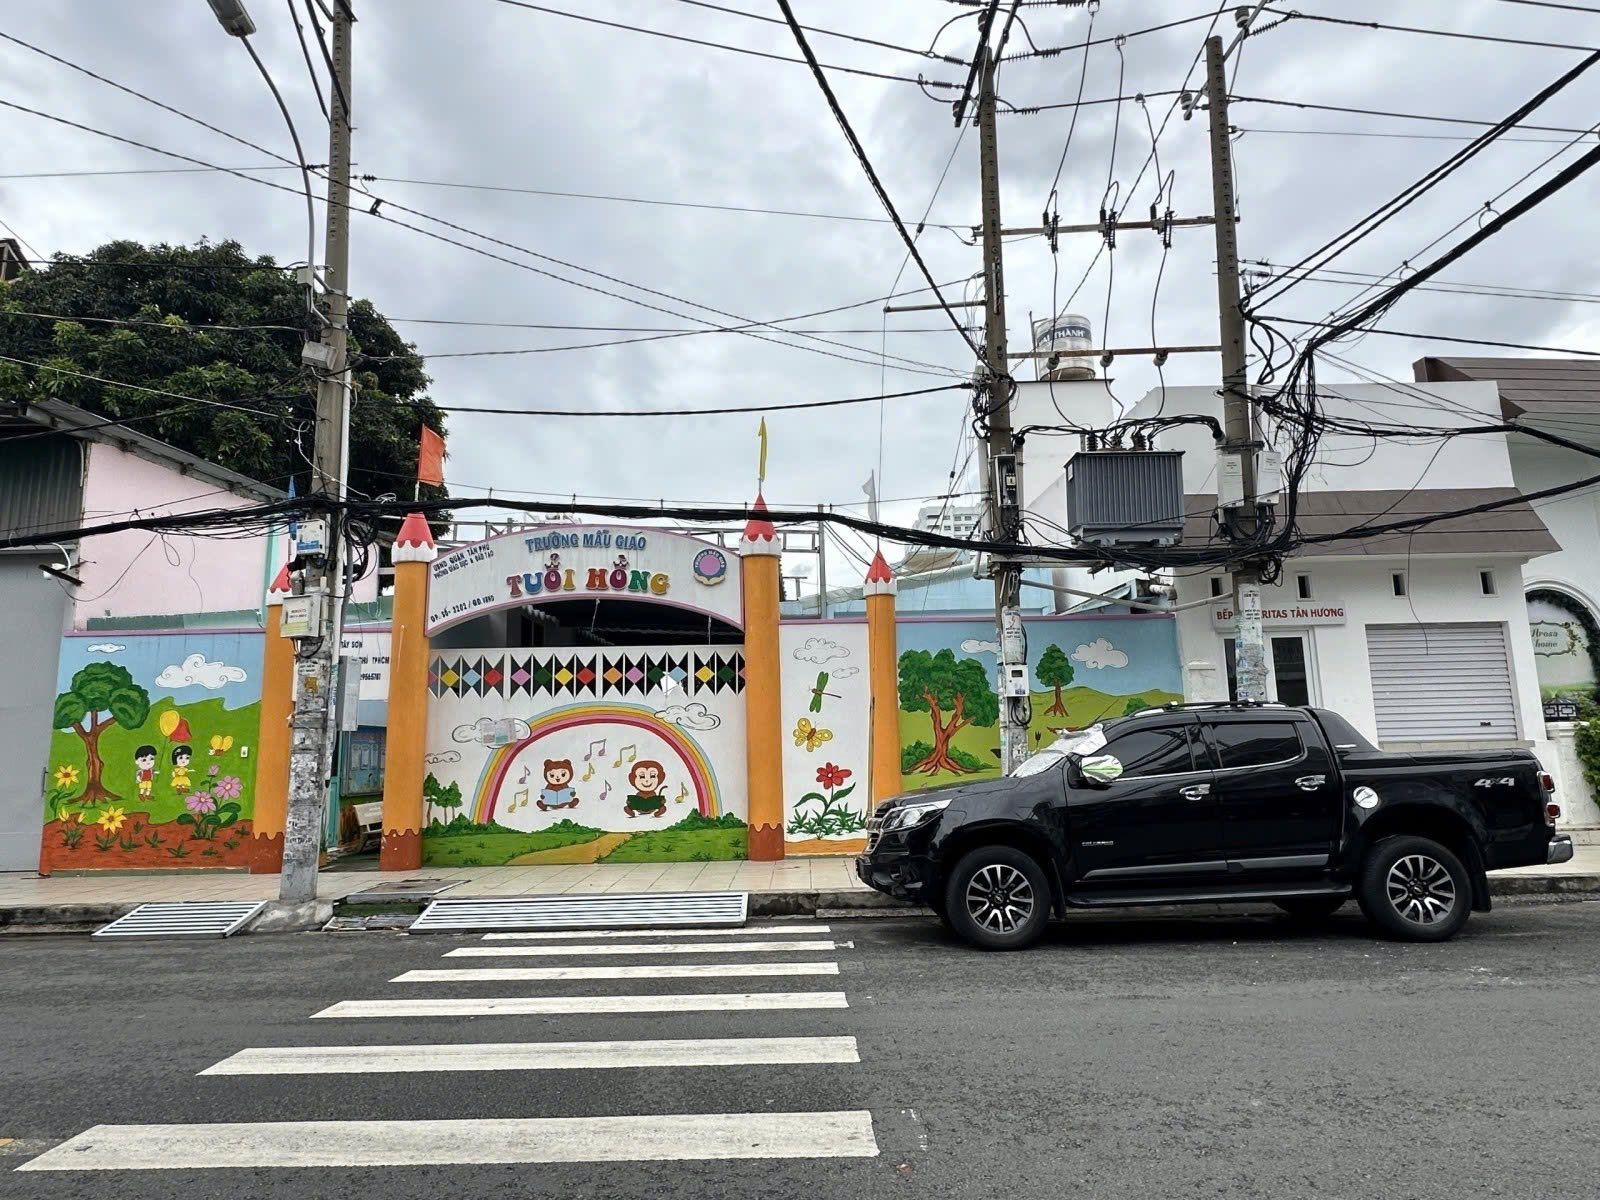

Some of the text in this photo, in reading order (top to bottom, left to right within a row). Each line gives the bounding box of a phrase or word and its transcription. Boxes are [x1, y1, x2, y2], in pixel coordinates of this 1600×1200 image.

[583, 529, 611, 548] MẪU
[615, 531, 647, 550] GIÁO
[506, 553, 576, 597] TUỔI
[1216, 608, 1234, 620] BẾP
[1262, 609, 1288, 619] RITAS
[1291, 606, 1309, 618] TÂN
[1310, 608, 1344, 618] HƯƠNG
